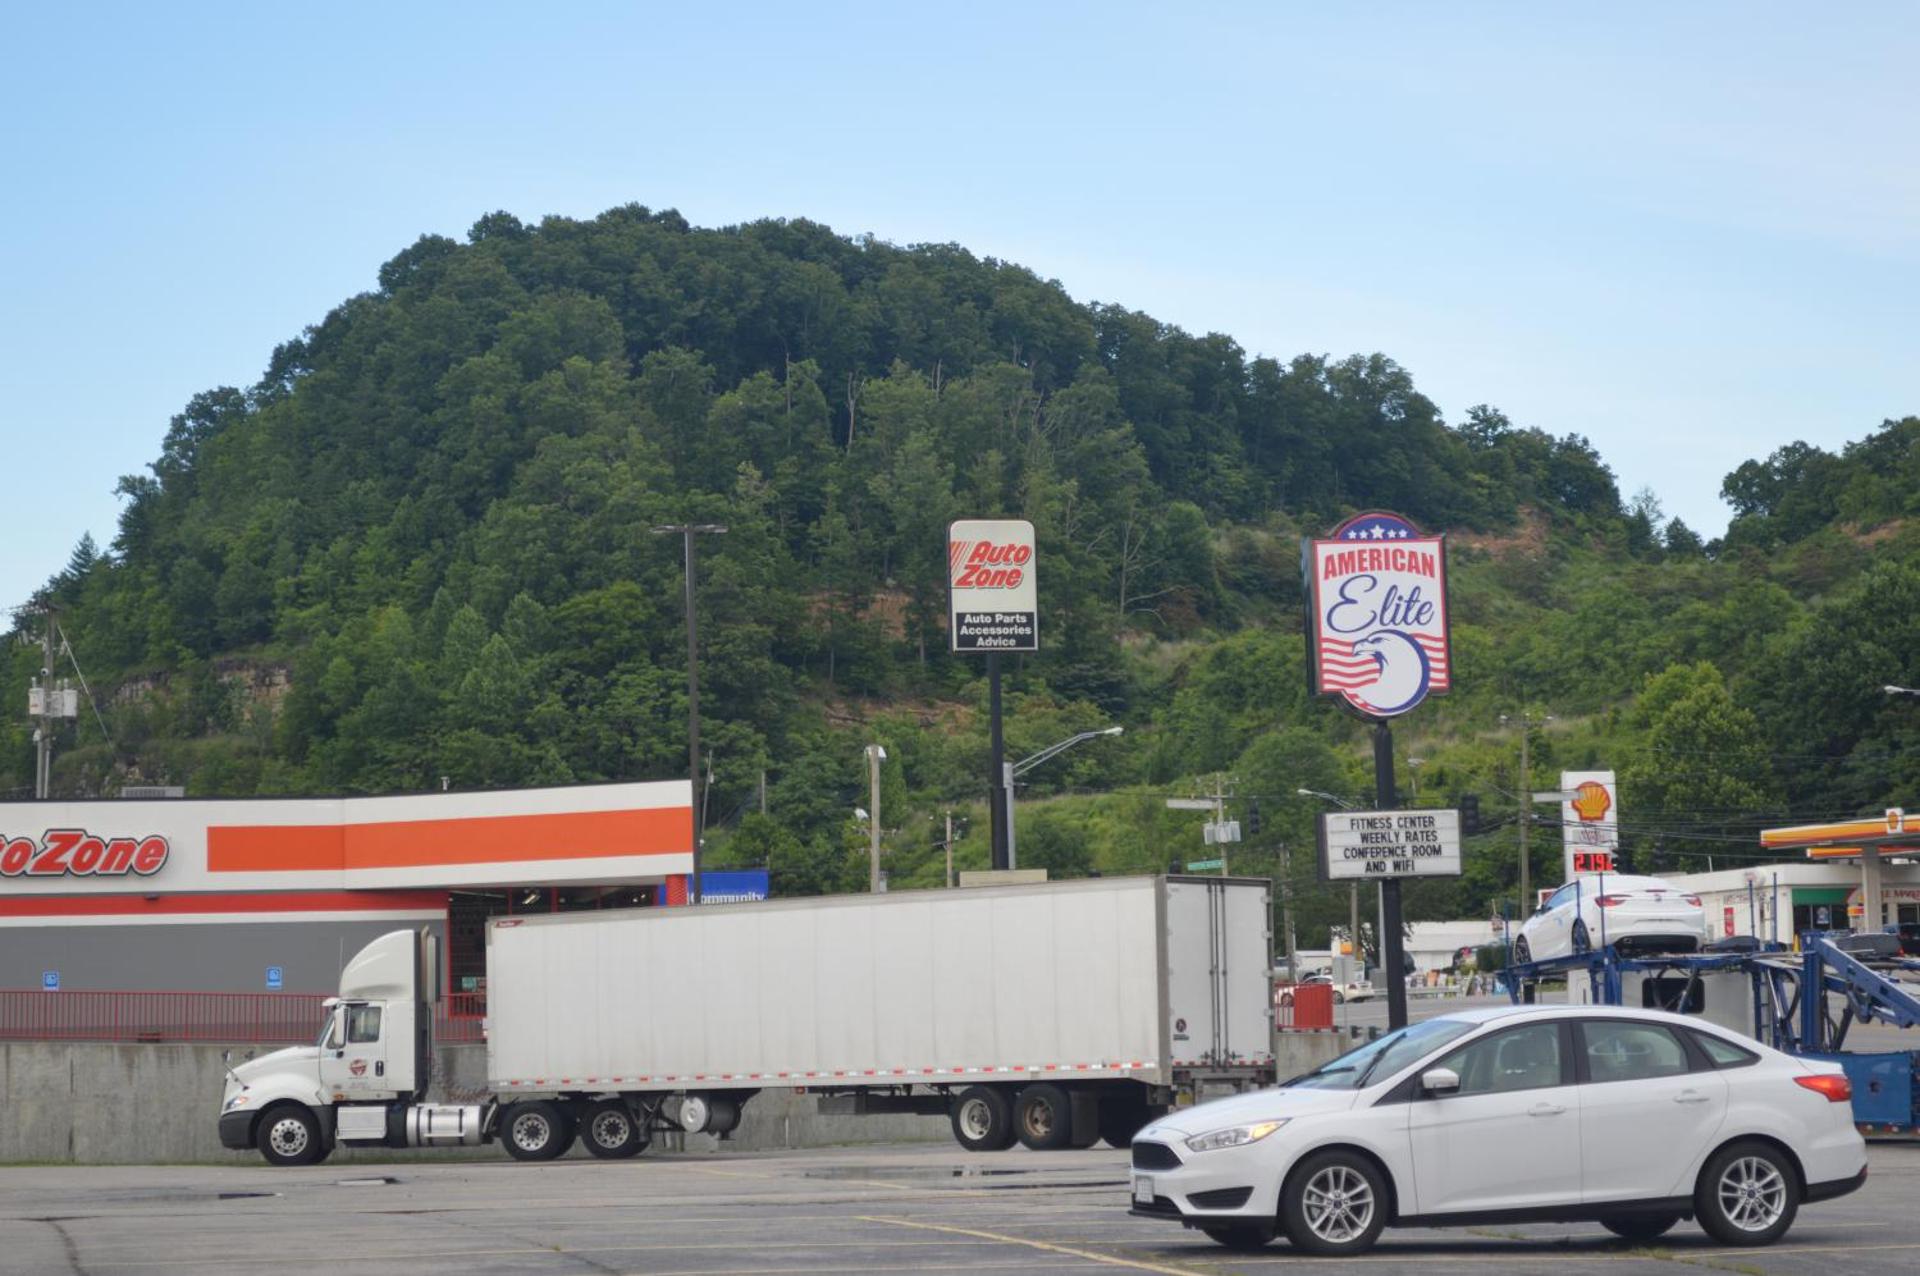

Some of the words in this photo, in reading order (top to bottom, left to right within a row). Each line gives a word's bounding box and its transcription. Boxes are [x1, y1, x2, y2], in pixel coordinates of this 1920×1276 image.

[967, 541, 1032, 565] Auto
[1324, 548, 1435, 580] AMERICAN
[953, 564, 1025, 589] Zone
[1326, 574, 1435, 634] Elite
[964, 614, 992, 625] Auto
[995, 614, 1027, 624] Parts
[960, 625, 1032, 636] Accessories
[976, 637, 1016, 647] Advice
[1350, 817, 1392, 830] FITNESS
[1397, 815, 1435, 829] CENTER
[1360, 831, 1400, 844] WEEKLY
[1405, 830, 1438, 842] RATES
[0, 829, 169, 877] oZone
[1343, 846, 1406, 859] CONFERENCE
[1411, 844, 1442, 857] ROOM
[1365, 861, 1386, 873] AND
[1393, 860, 1415, 873] WIFI
